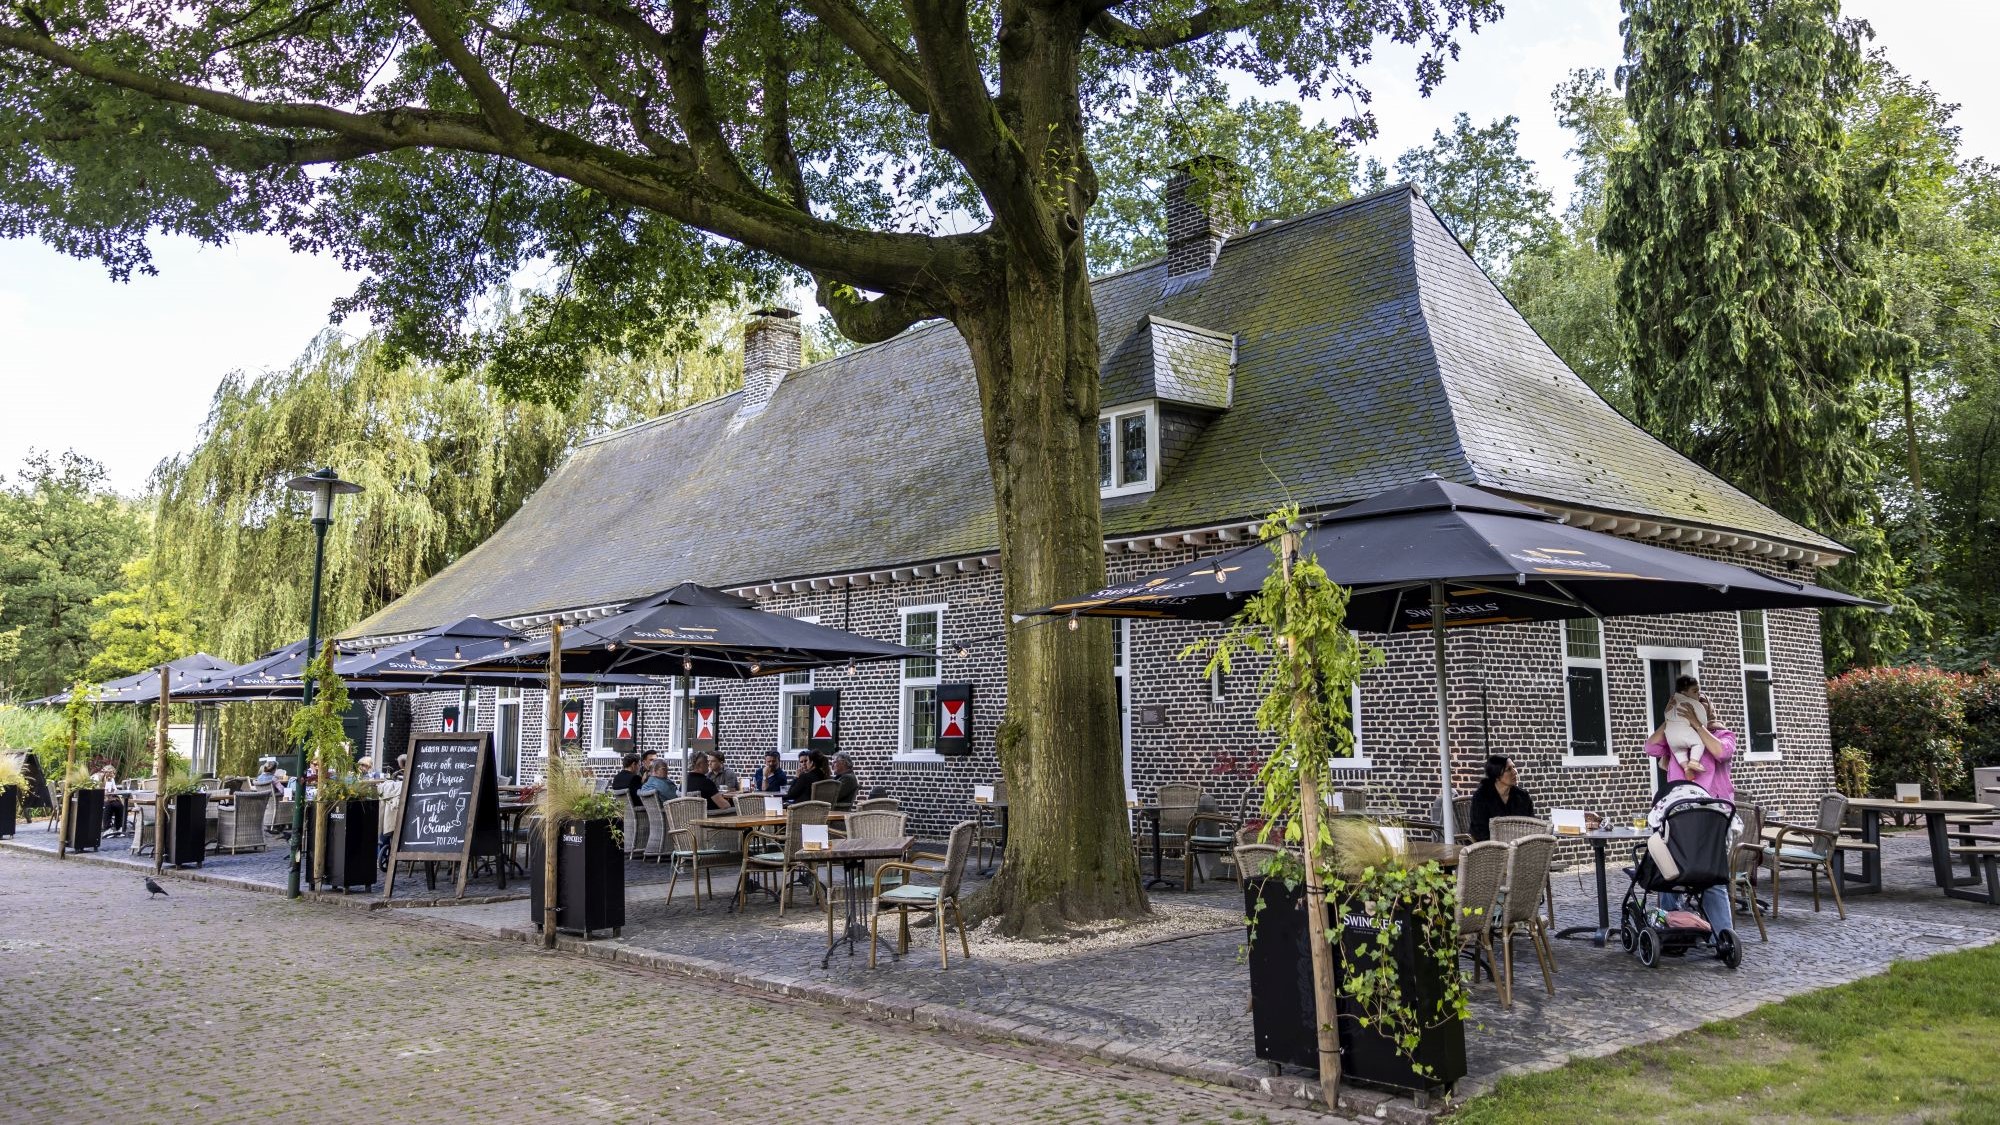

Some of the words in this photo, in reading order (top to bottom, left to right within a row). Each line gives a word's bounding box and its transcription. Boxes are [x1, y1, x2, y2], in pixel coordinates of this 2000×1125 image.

[1405, 602, 1500, 618] SWCKELS'
[418, 798, 448, 814] Tinto
[428, 811, 440, 823] de
[412, 815, 453, 839] Verano
